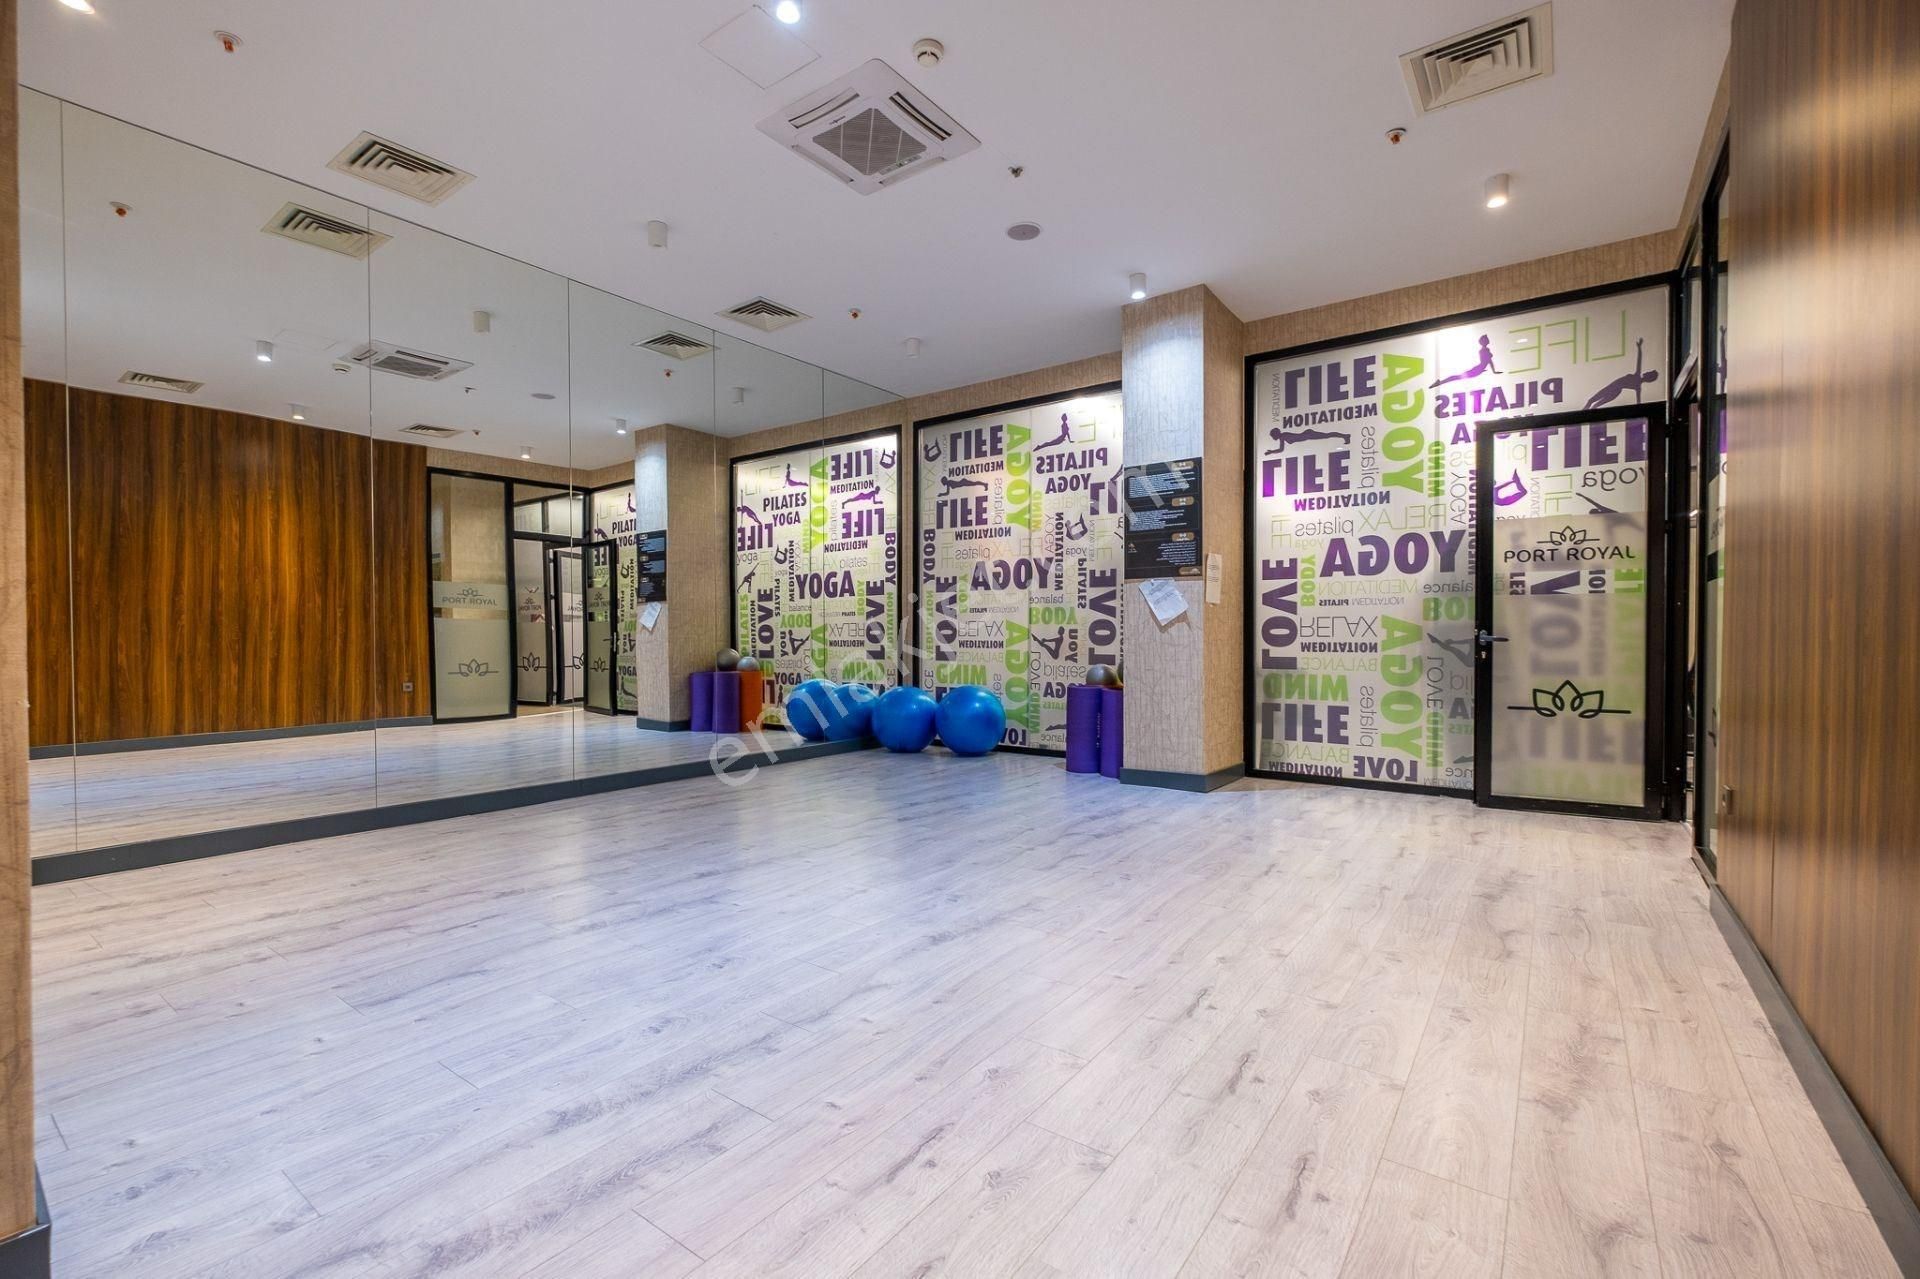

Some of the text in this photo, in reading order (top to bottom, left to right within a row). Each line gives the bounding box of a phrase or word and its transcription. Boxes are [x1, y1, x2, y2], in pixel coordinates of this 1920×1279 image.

[831, 448, 873, 481] LIFE
[830, 479, 875, 494] MEDITATION
[763, 491, 808, 512] PILATES
[772, 511, 801, 527] YOGA
[842, 507, 885, 539] LIFE
[737, 523, 773, 551] LIFE
[824, 539, 868, 553] MEDITATION
[885, 532, 897, 586] BODY
[1503, 545, 1637, 563] PORT ROYAL
[795, 570, 855, 600] YOGA
[442, 596, 498, 607] PORT ROYAL
[757, 588, 774, 659] LOVE
[780, 613, 811, 629] BODY
[866, 579, 885, 660] LOVE
[774, 672, 801, 685] YOGA
